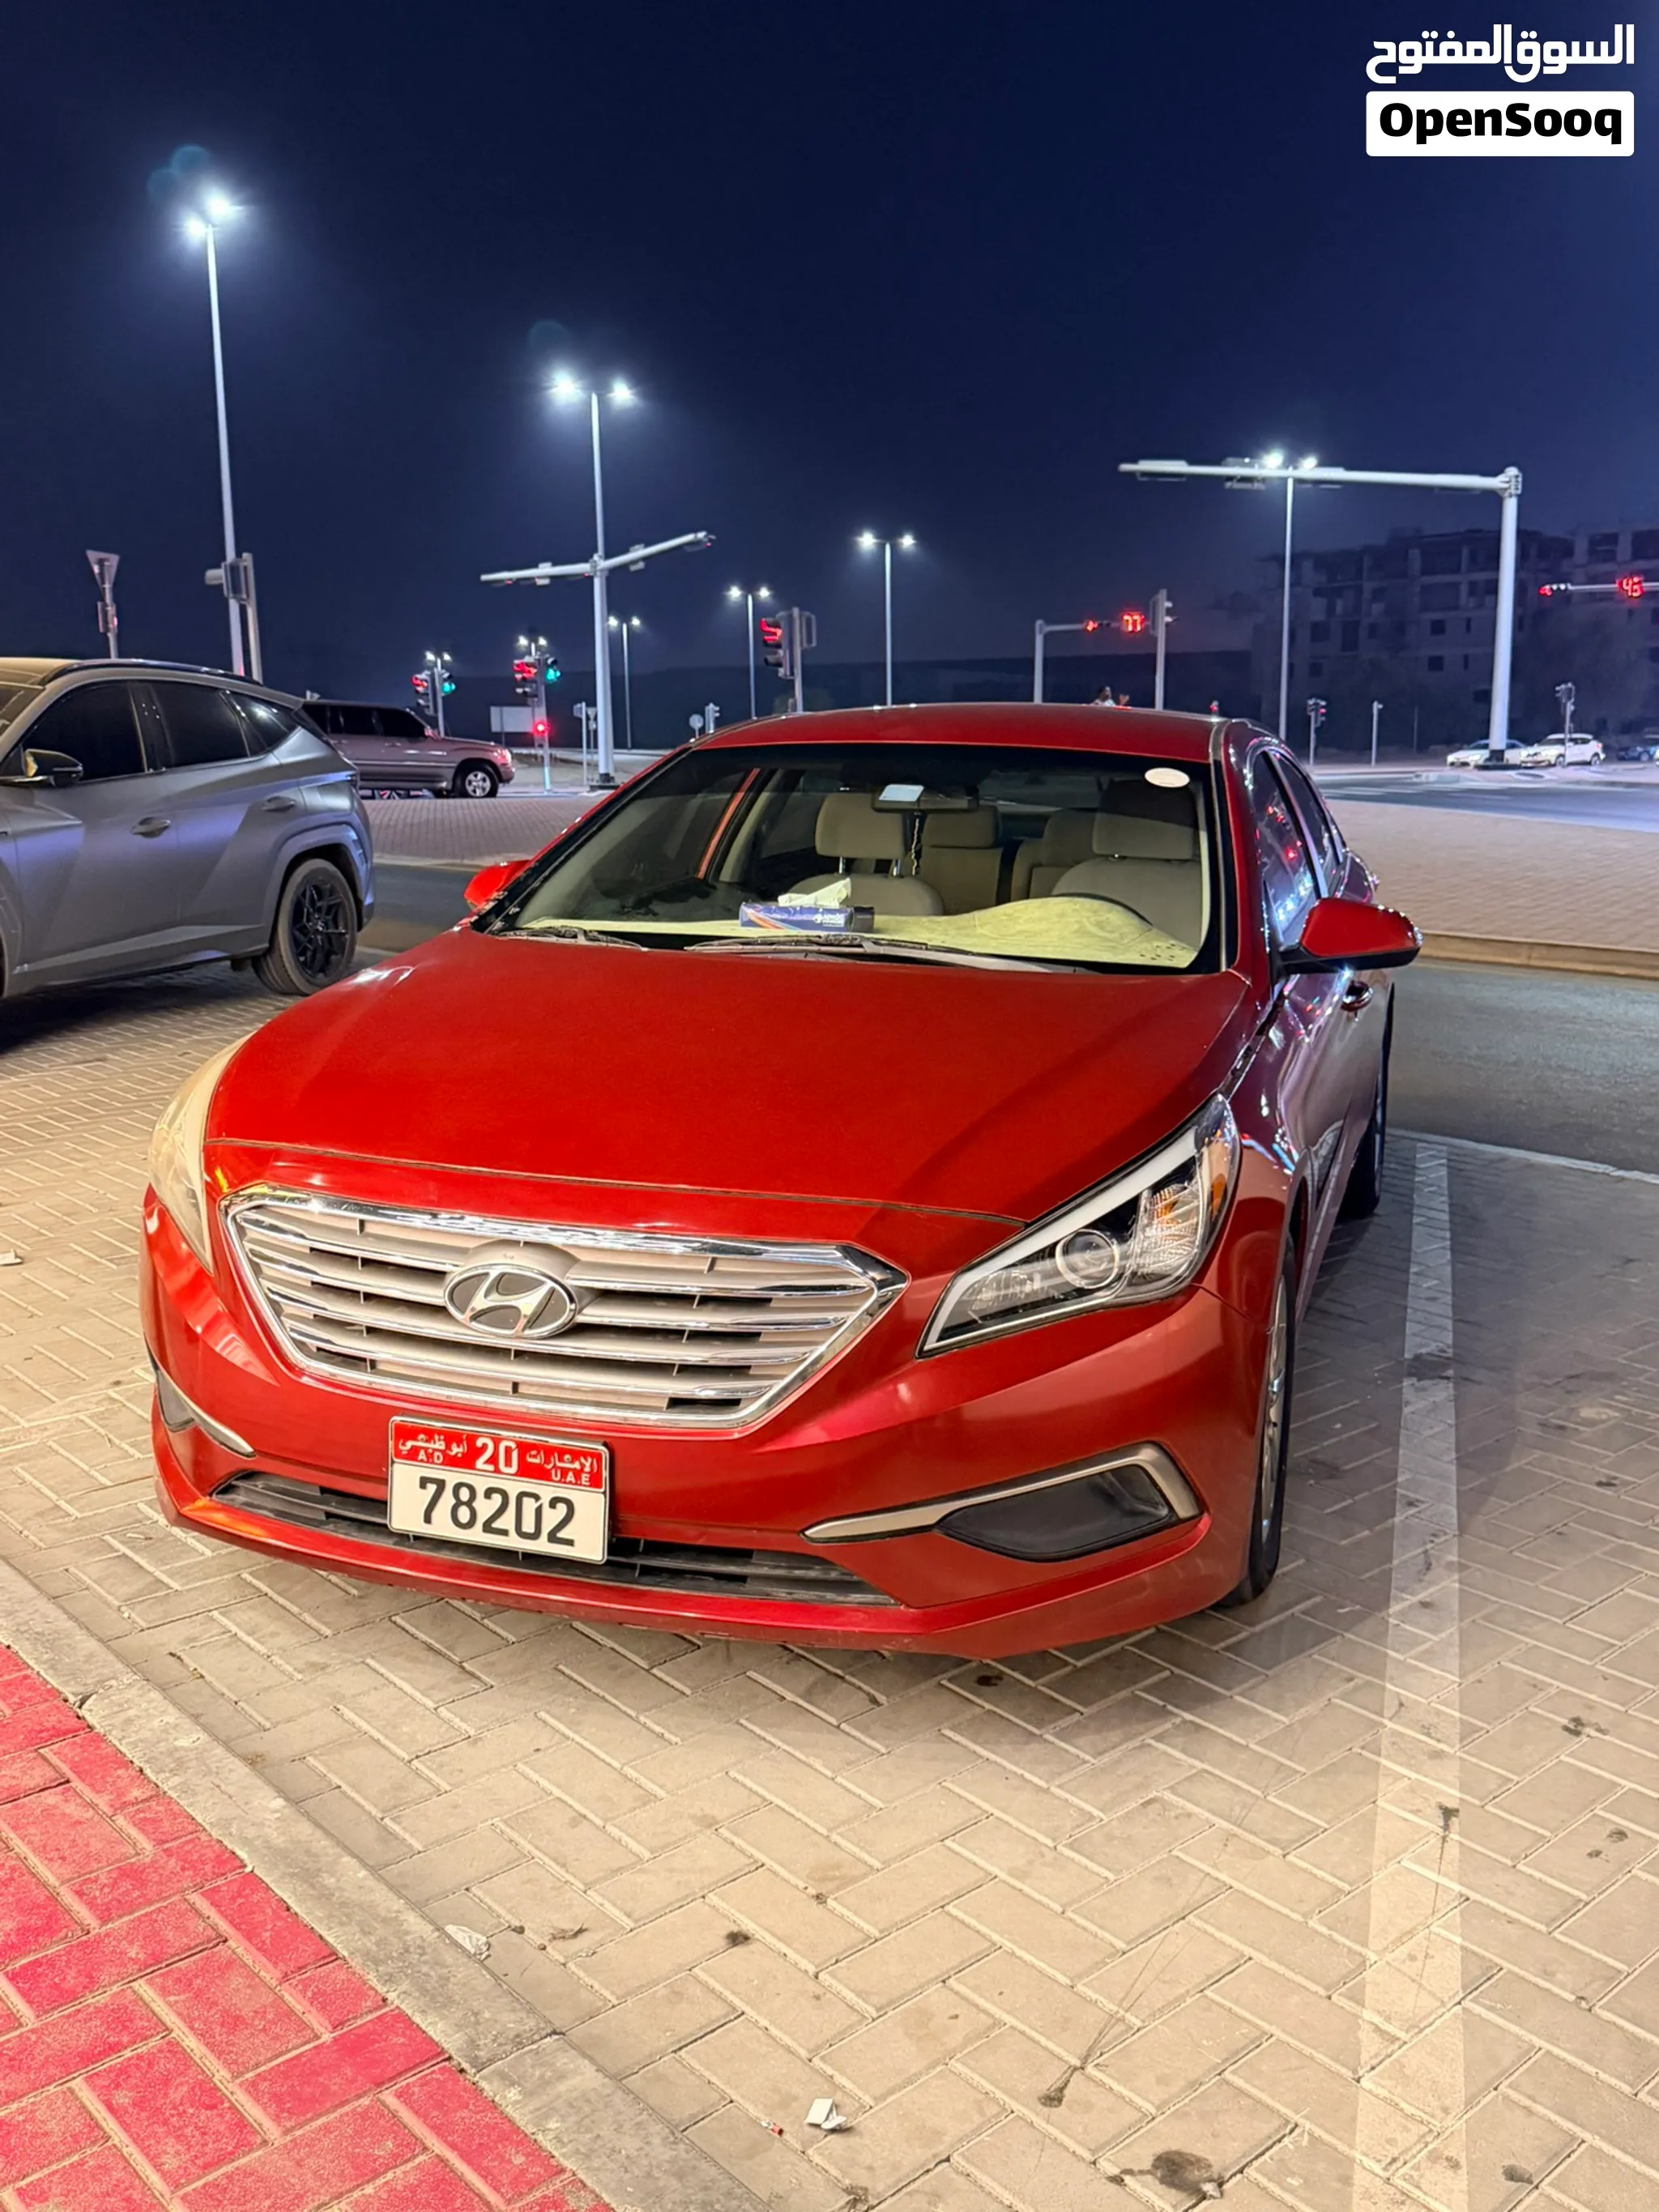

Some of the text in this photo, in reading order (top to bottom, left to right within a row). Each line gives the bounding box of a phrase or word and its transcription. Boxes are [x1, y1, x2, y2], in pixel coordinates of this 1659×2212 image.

[475, 1437, 518, 1474] 20
[551, 1468, 591, 1486] U.A.E
[419, 1476, 575, 1547] 78202
